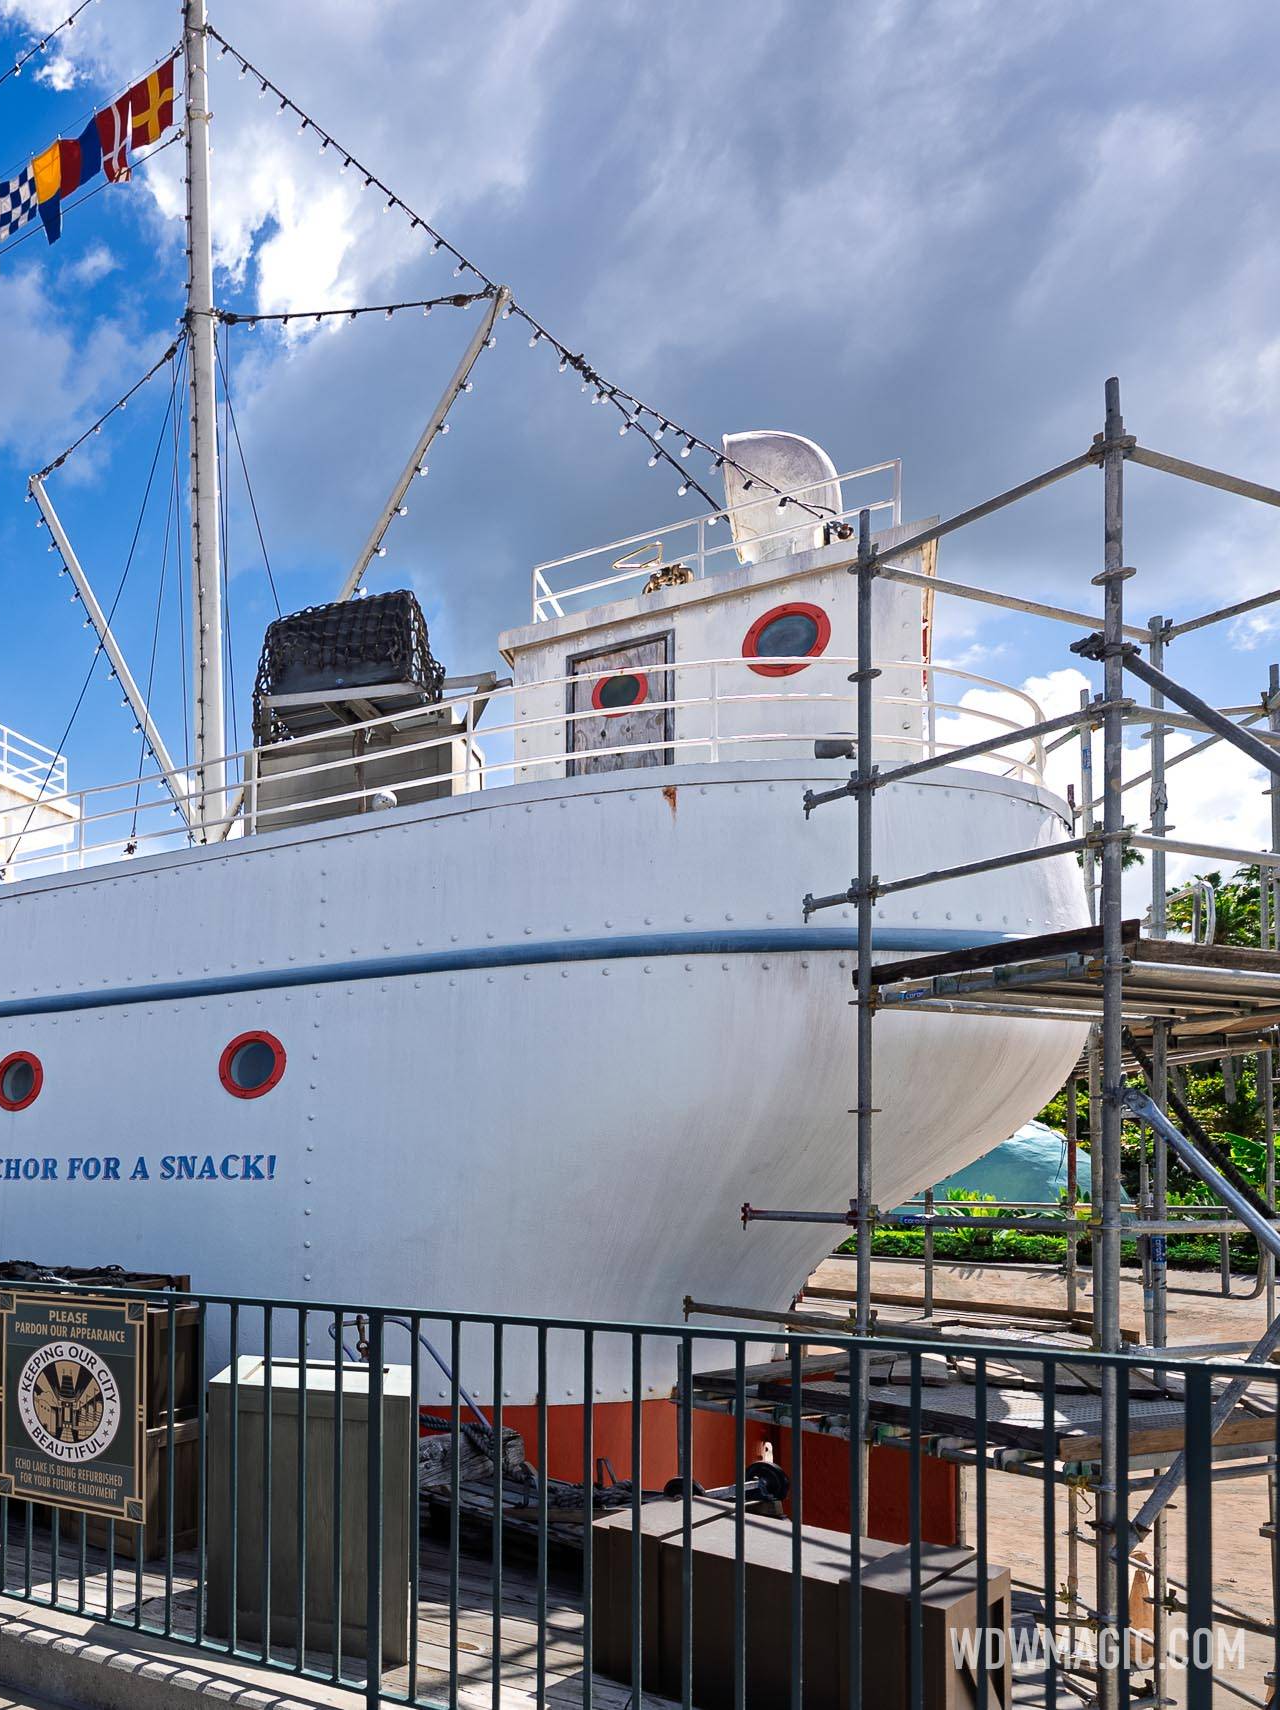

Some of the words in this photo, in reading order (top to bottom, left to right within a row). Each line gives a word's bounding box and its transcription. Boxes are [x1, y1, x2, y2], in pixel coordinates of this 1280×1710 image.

[66, 1157, 120, 1181] FOR
[129, 1156, 150, 1181] A
[159, 1154, 278, 1181] SNACK!
[49, 1310, 88, 1325] PLEASE
[15, 1322, 48, 1336] PARDON
[50, 1324, 68, 1338] OUR
[70, 1326, 126, 1343] APPEARANCE
[22, 1345, 64, 1393] KEEPING
[68, 1346, 98, 1370] OUR
[97, 1369, 118, 1404] CITY
[31, 1426, 105, 1459] BEAUTIFUL
[15, 1457, 31, 1471] ECHO
[32, 1460, 48, 1474] LAKE
[49, 1463, 55, 1474] IS
[56, 1464, 77, 1478] BEING
[77, 1468, 123, 1487] REFURBISHED
[20, 1471, 33, 1484] FOR
[34, 1473, 51, 1487] YOUR
[52, 1477, 78, 1492] FUTURE
[78, 1481, 117, 1500] ENJOYMENT
